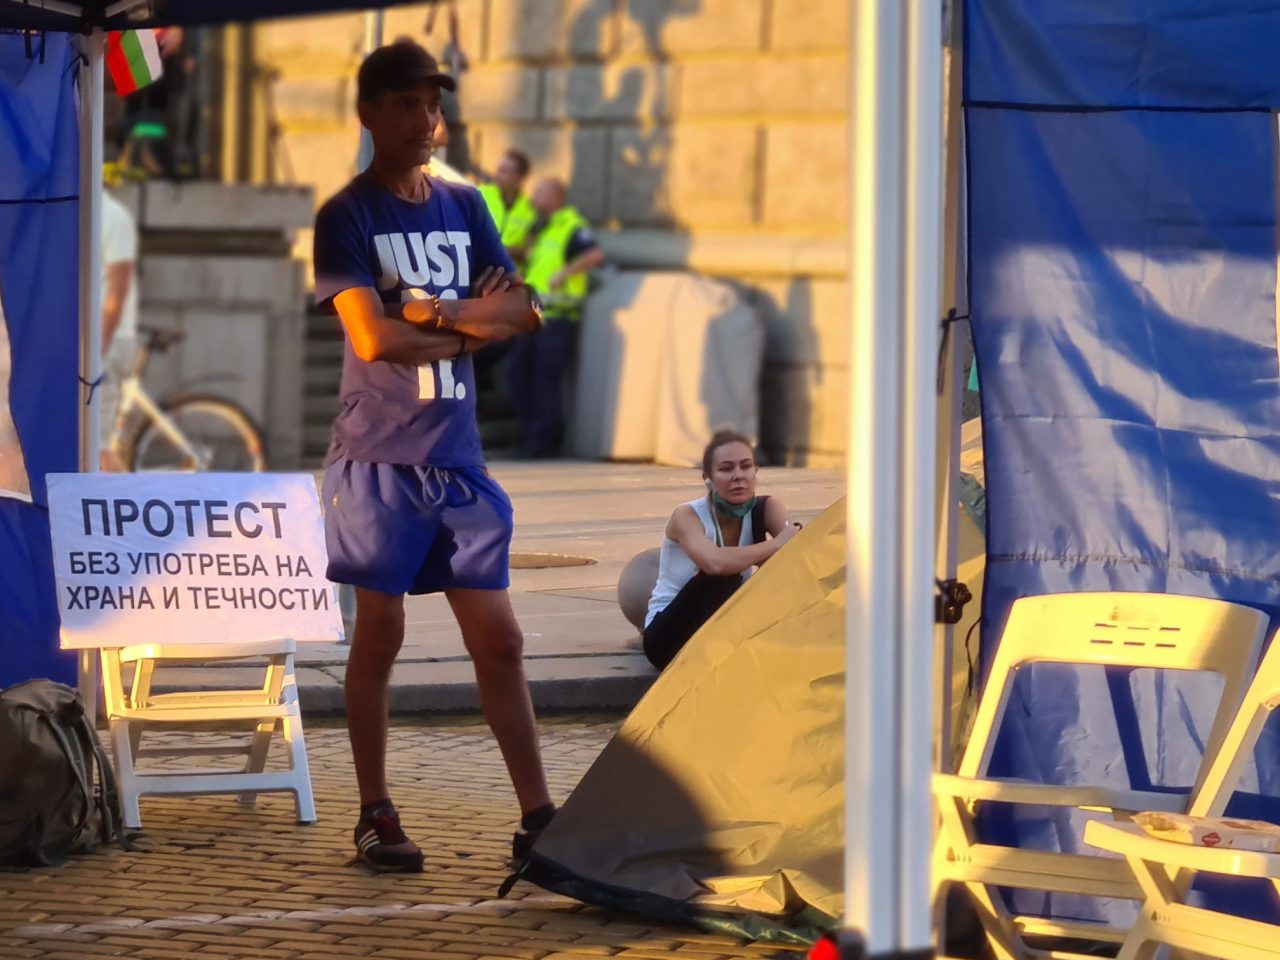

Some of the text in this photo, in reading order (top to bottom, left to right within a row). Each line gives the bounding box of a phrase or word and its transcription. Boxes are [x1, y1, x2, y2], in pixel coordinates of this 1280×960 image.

[374, 231, 471, 290] JUST
[81, 498, 287, 539] ПРОТЕСТ
[69, 551, 313, 578] БЕЗ УПОТРЕБА НА
[66, 585, 329, 611] ХРАНА И ТЕЧНОСТИ
